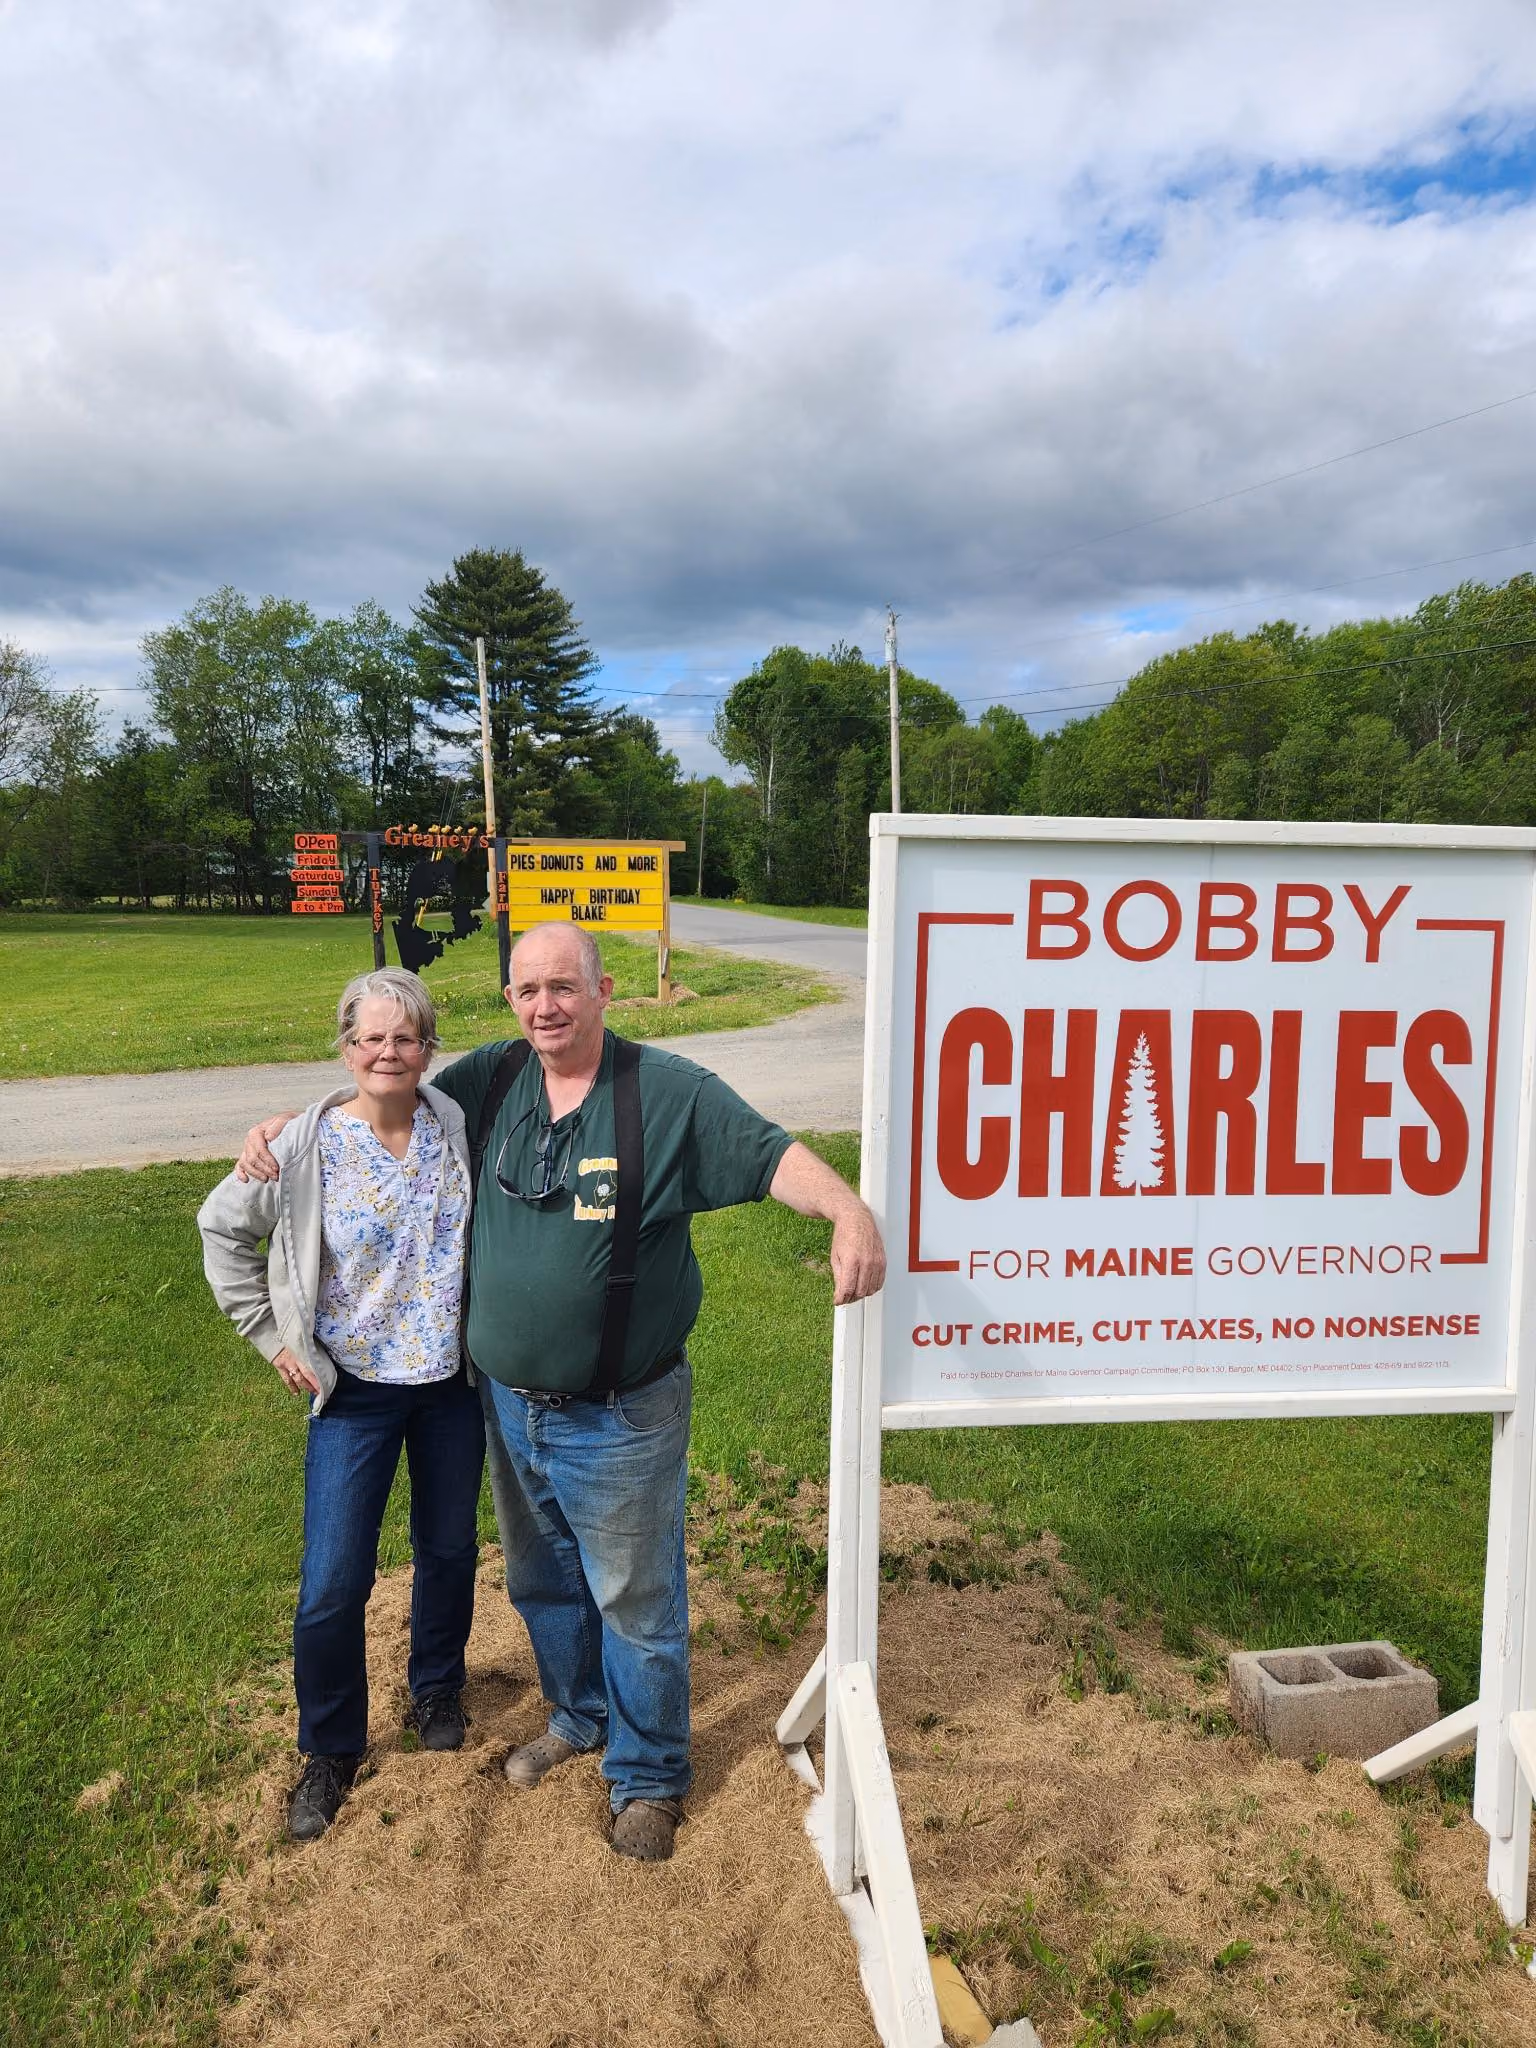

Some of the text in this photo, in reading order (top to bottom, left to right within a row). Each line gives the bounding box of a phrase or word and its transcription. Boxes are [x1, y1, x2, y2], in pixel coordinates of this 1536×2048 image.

[384, 824, 489, 852] Greaney's
[297, 855, 336, 865] Friday
[510, 854, 535, 870] PIES
[540, 855, 584, 871] DONUTS
[595, 856, 617, 871] AND
[292, 871, 342, 880] Saturday
[298, 887, 338, 897] Sunday
[369, 868, 383, 933] Turkey
[497, 871, 509, 912] Farm
[541, 889, 641, 904] HAPPY BIRTHDAY
[304, 902, 315, 911] to
[1026, 878, 1413, 963] BOBBY
[936, 1006, 1473, 1200] CHARLES
[968, 1245, 1433, 1280] FOR MAINE GOVERNOR
[911, 1315, 1481, 1348] CUT CRIME, CUT TAXES, NO NONSENSE
[940, 1371, 957, 1380] Paid
[958, 1371, 968, 1379] for
[970, 1371, 979, 1381] by
[980, 1370, 1003, 1379] Bobby
[1004, 1369, 1033, 1378] Charles
[1034, 1369, 1044, 1377] for
[1045, 1368, 1068, 1377] Maine
[1069, 1367, 1101, 1376] Governor
[1103, 1367, 1139, 1376] Campaign
[1257, 1364, 1269, 1372] ME
[1296, 1364, 1312, 1373] Sign
[1313, 1363, 1350, 1371] Placement
[1403, 1361, 1418, 1369] and
